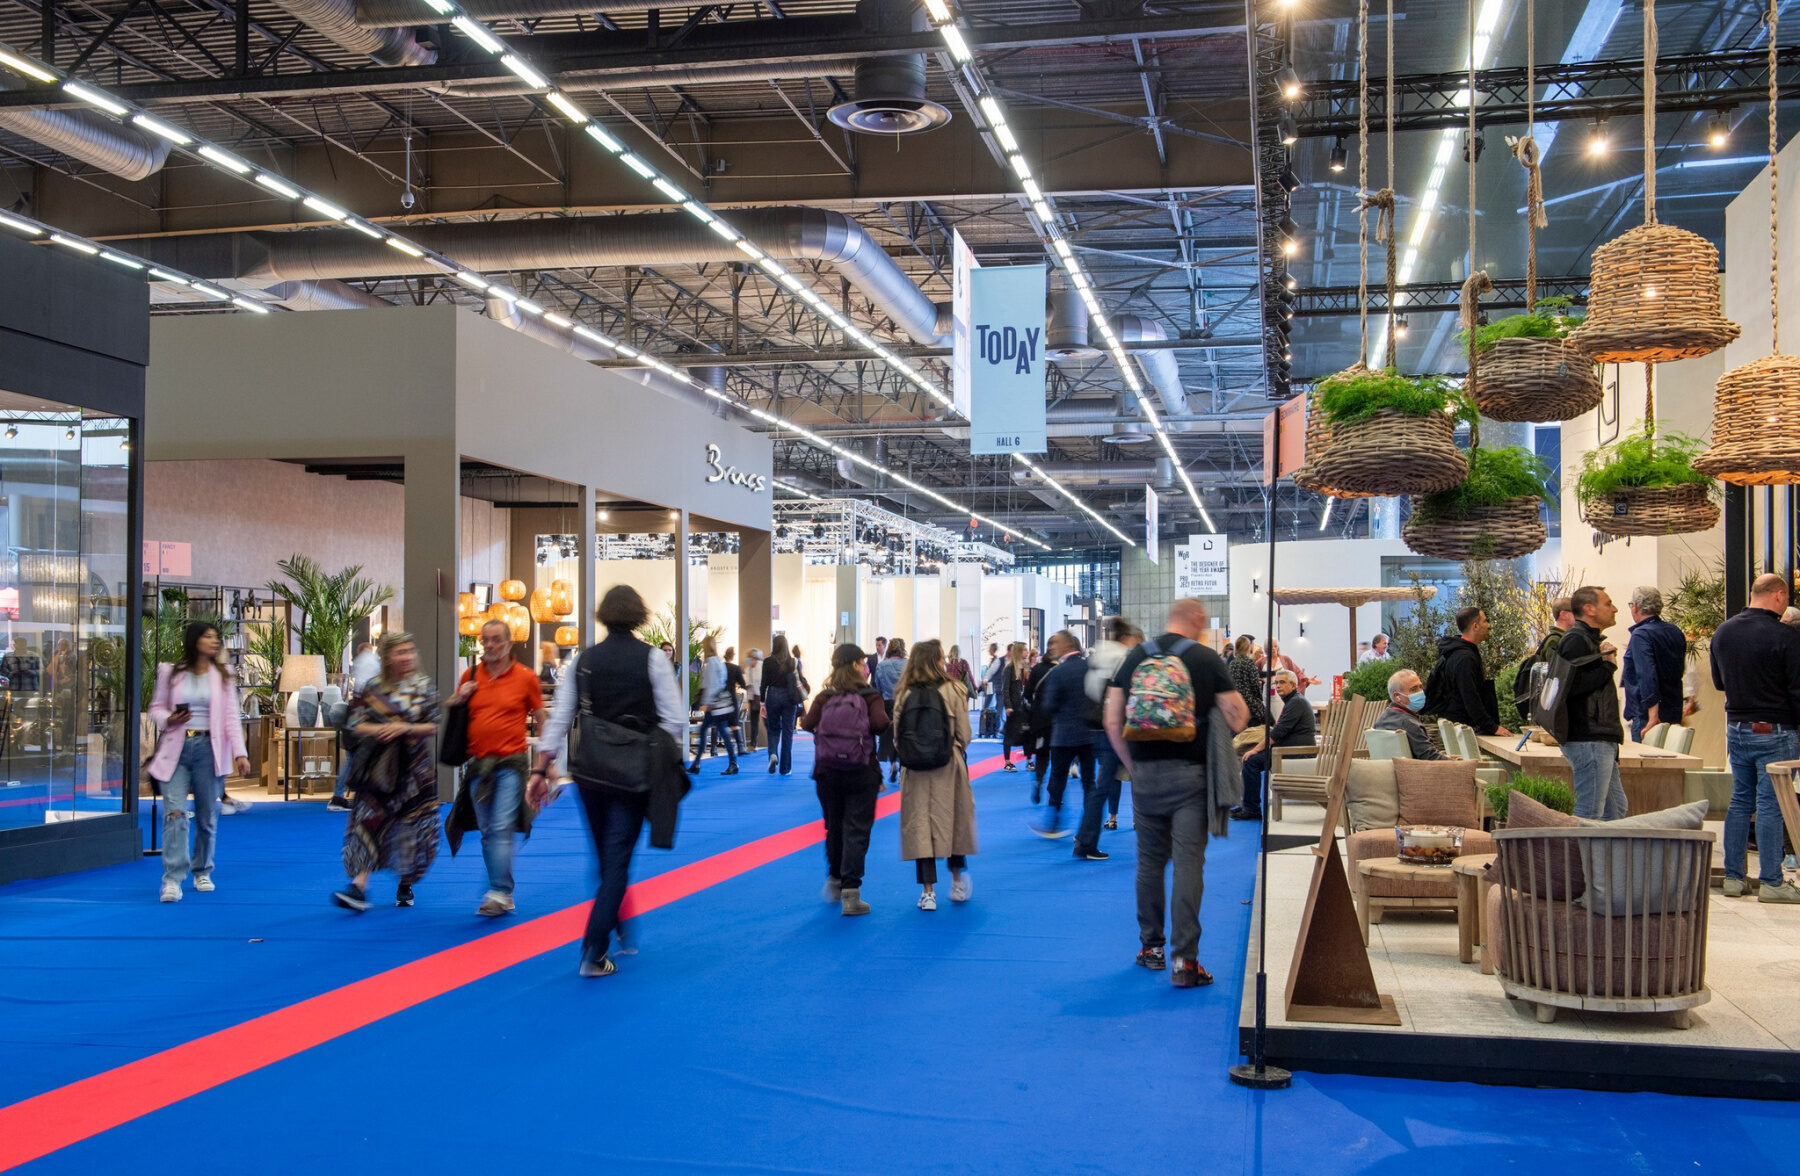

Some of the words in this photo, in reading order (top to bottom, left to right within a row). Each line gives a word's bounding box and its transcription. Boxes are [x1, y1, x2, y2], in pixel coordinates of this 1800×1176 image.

[975, 324, 1040, 374] TODAY
[997, 437, 1012, 446] HALL
[1015, 436, 1020, 446] 6
